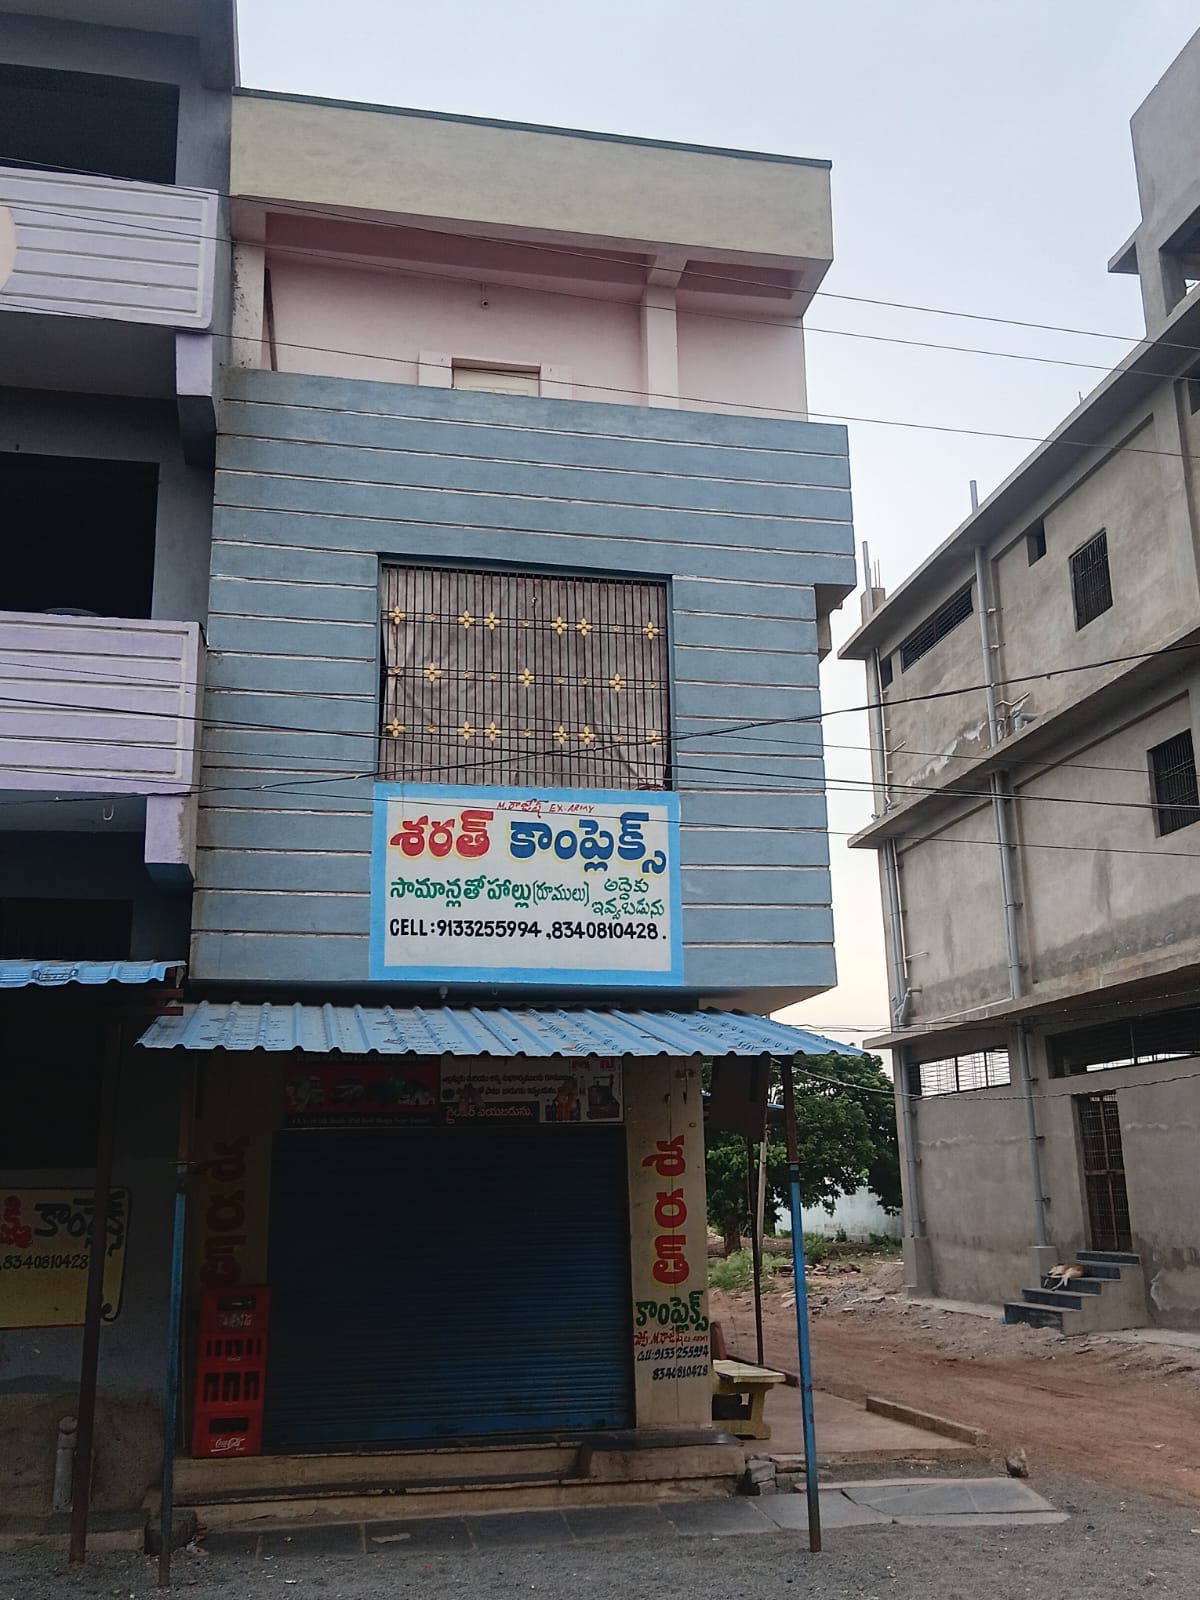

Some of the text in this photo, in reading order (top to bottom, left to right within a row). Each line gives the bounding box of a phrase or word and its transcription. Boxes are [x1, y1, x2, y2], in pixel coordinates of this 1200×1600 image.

[389, 809, 668, 875] శరత్ కాంప్లెక్స్
[604, 876, 649, 900] అద్దెకు
[635, 1290, 709, 1332] కాంప్లెక్స్
